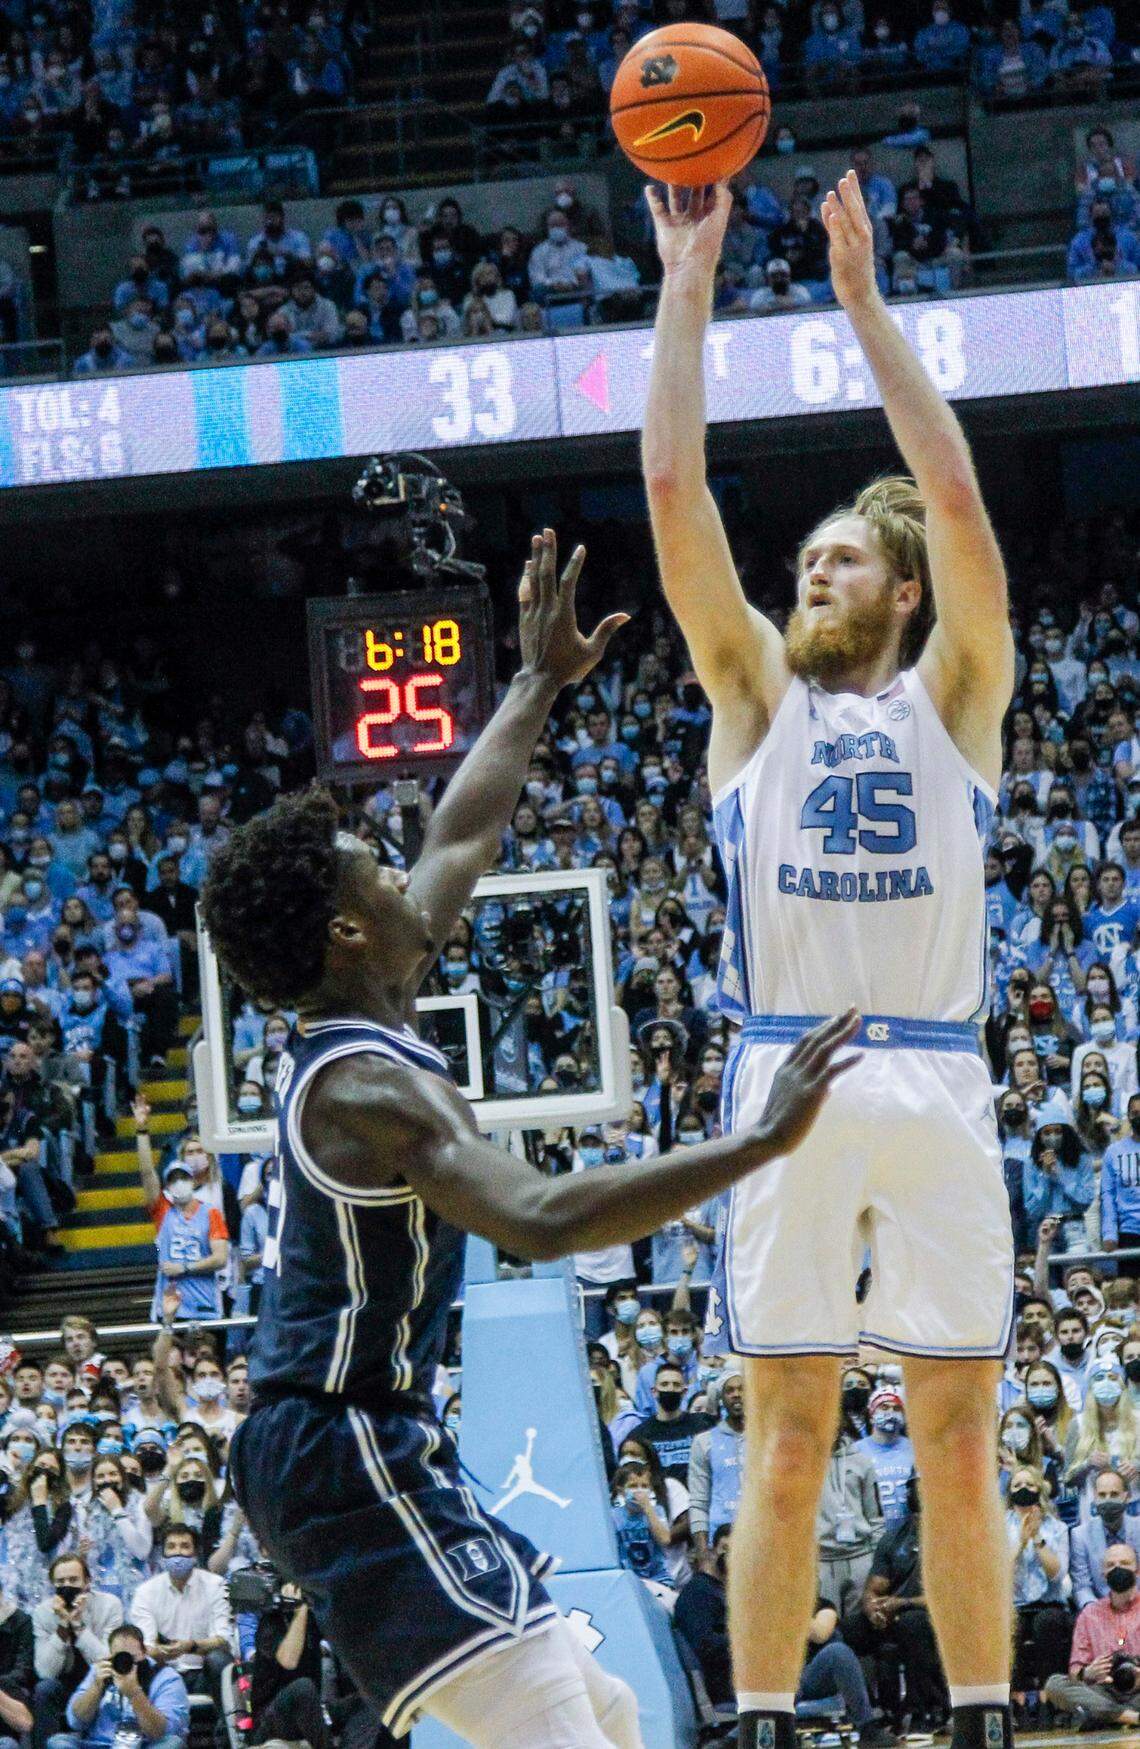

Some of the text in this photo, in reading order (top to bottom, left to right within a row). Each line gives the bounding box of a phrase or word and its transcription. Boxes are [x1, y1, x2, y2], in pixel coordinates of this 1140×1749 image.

[98, 386, 119, 425] 4
[429, 351, 516, 440] 33
[365, 619, 461, 671] 6:18
[356, 674, 453, 759] 25
[801, 771, 918, 855] 45
[778, 863, 934, 902] CAROLINA
[169, 1237, 201, 1262] 23
